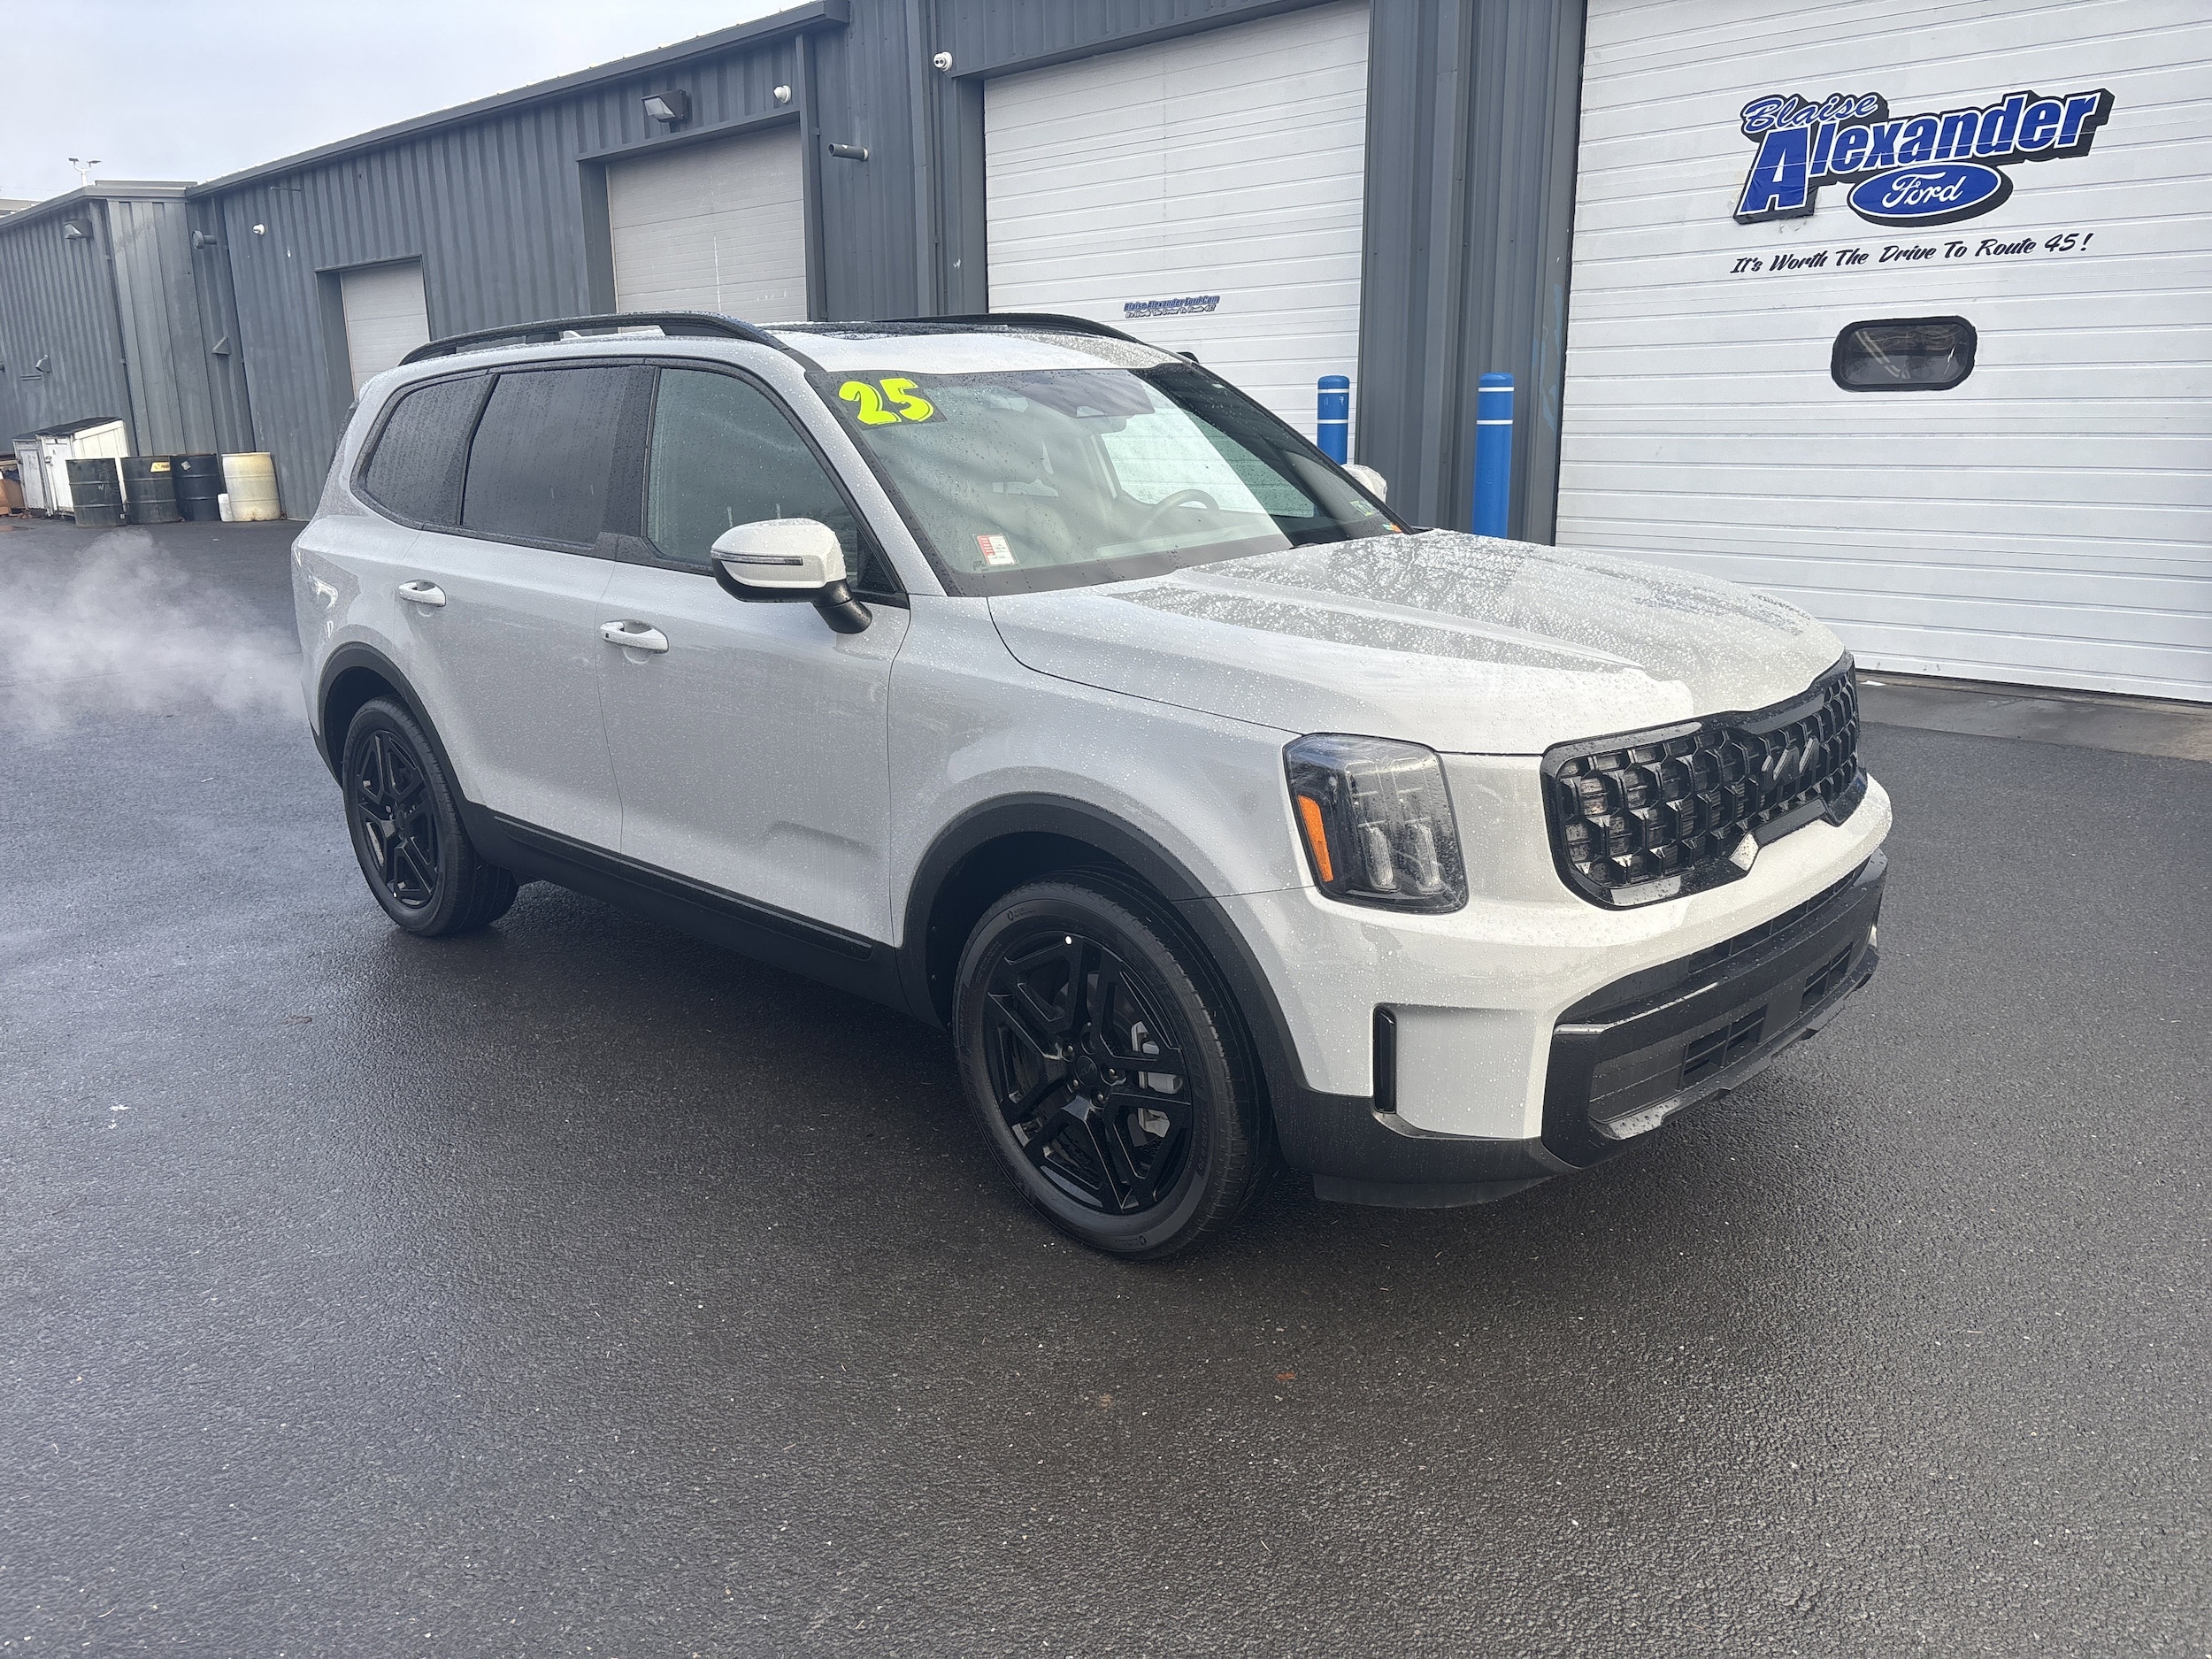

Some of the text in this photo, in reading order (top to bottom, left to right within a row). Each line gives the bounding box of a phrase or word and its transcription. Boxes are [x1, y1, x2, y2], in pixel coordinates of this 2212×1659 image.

[1743, 92, 1879, 133] Blaise
[1737, 91, 2102, 216] Alexander
[1881, 172, 1964, 208] Ford
[1731, 257, 1763, 274] It's
[1770, 252, 1829, 272] Worth
[1835, 248, 1869, 266] The
[1878, 243, 1937, 263] Drive
[1944, 240, 1968, 258] To
[1975, 237, 2036, 256] Route
[838, 377, 934, 425] 25
